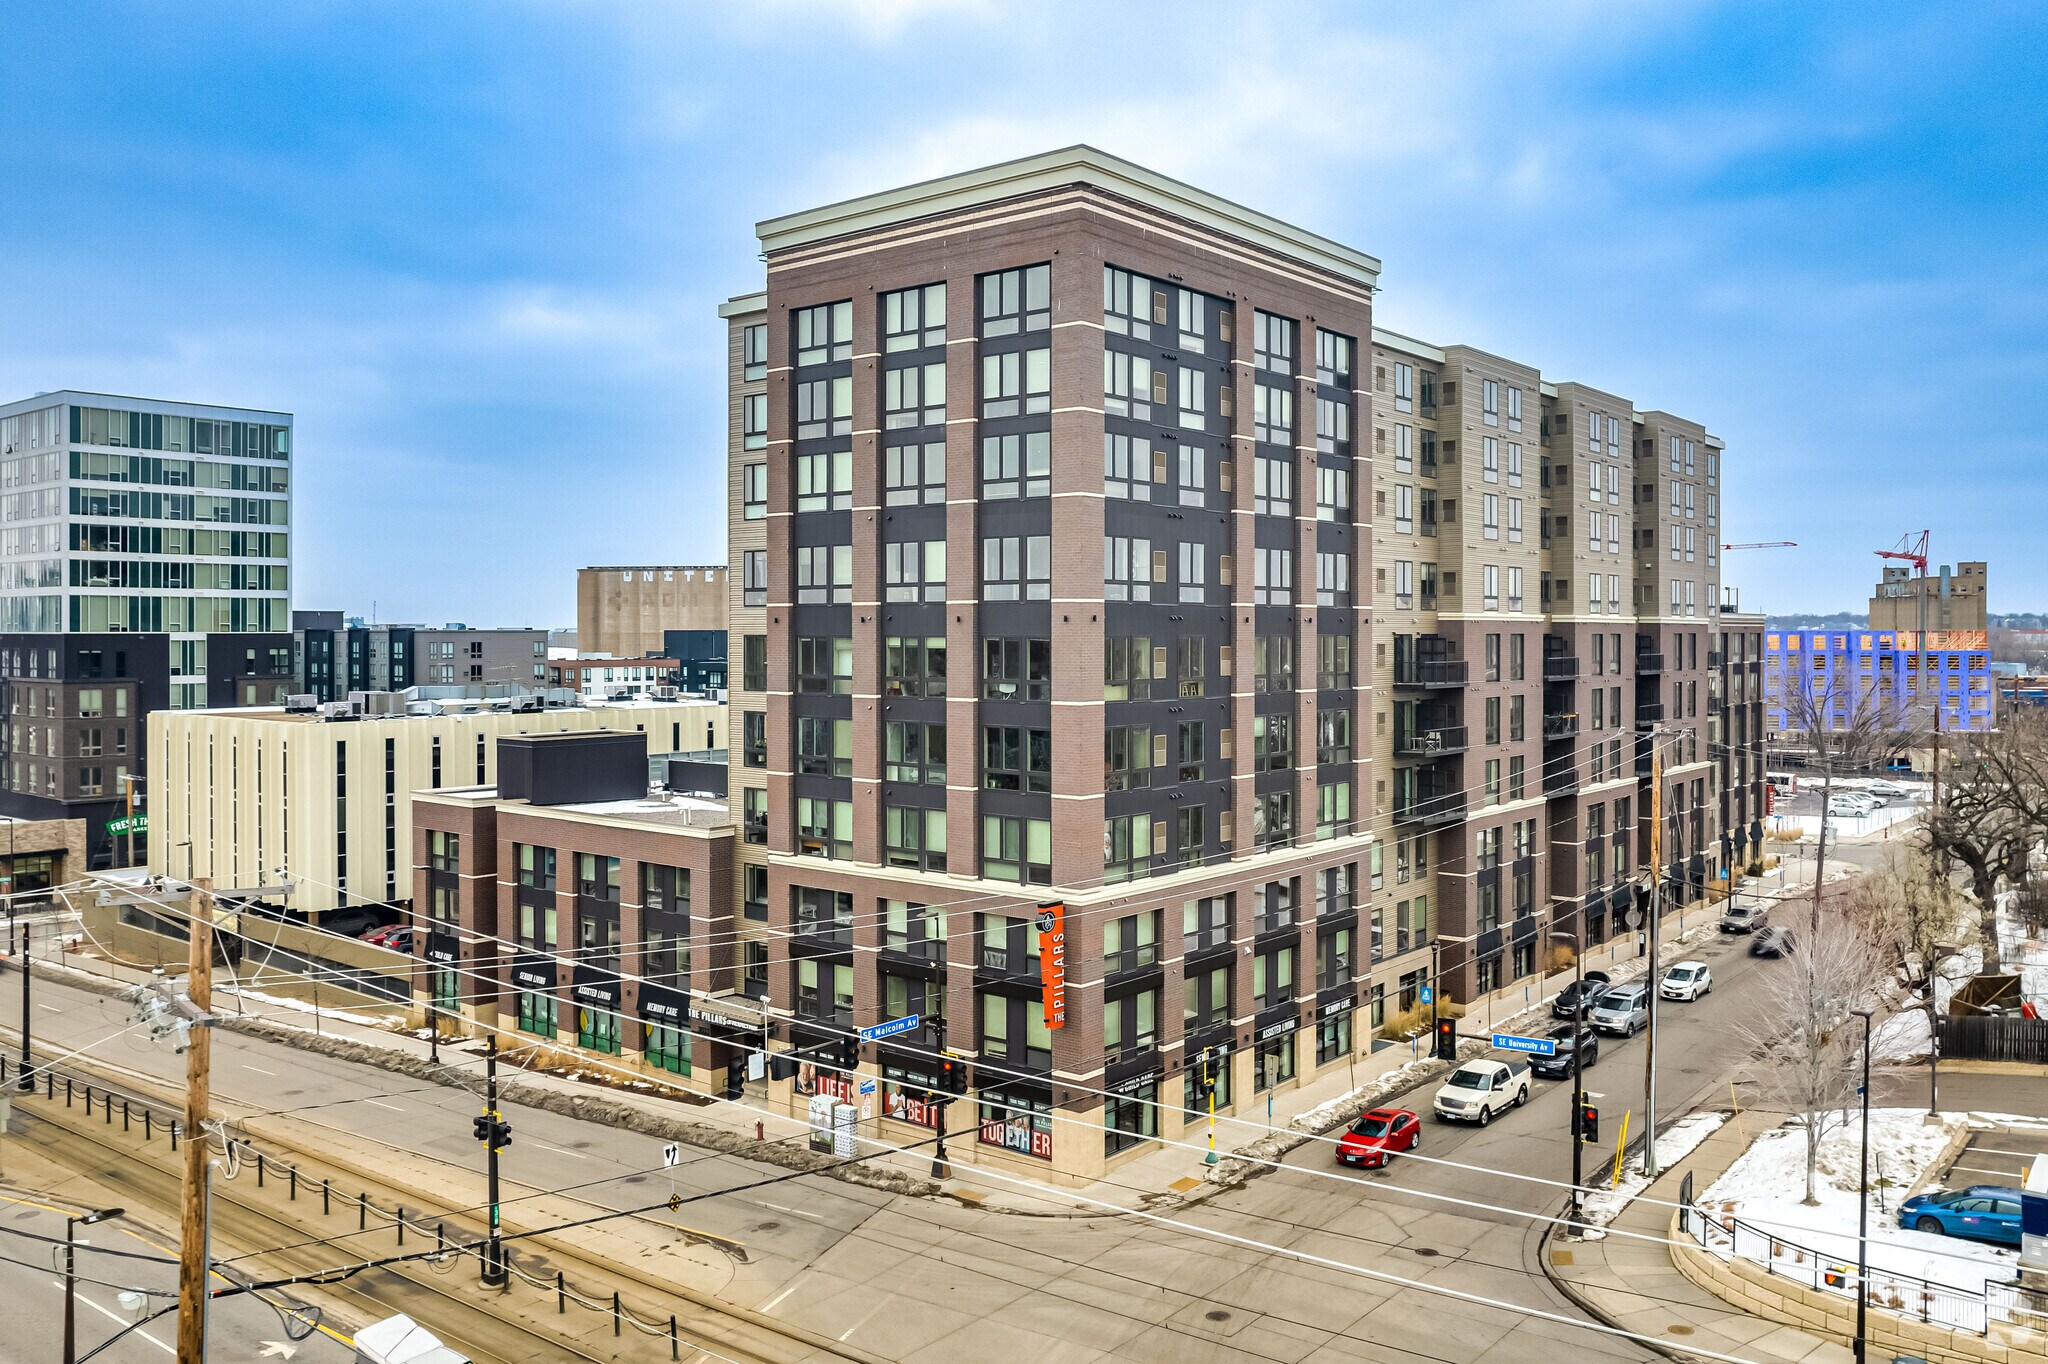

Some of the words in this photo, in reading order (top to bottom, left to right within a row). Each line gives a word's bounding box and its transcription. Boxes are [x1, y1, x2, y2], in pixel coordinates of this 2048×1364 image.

[622, 570, 728, 582] UNITE
[110, 818, 138, 832] FRESH
[520, 972, 534, 982] SENIOR
[534, 974, 546, 984] LIVING
[1053, 933, 1065, 1009] PILLARS
[578, 986, 598, 998] ASSISTED
[598, 990, 612, 1000] LIVING
[646, 1002, 666, 1014] MEMORY
[666, 1006, 678, 1016] CARE
[1342, 998, 1350, 1010] CARE
[688, 1008, 700, 1018] THE
[702, 1012, 726, 1026] PILLARS
[1054, 1012, 1064, 1022] THE
[862, 1030, 872, 1038] SE
[876, 1022, 904, 1036] Malcolm
[1262, 1024, 1280, 1038] ASSISTED
[1282, 1020, 1294, 1032] LIVING
[1508, 1038, 1538, 1050] University
[981, 1118, 1051, 1156] TOGETHER
